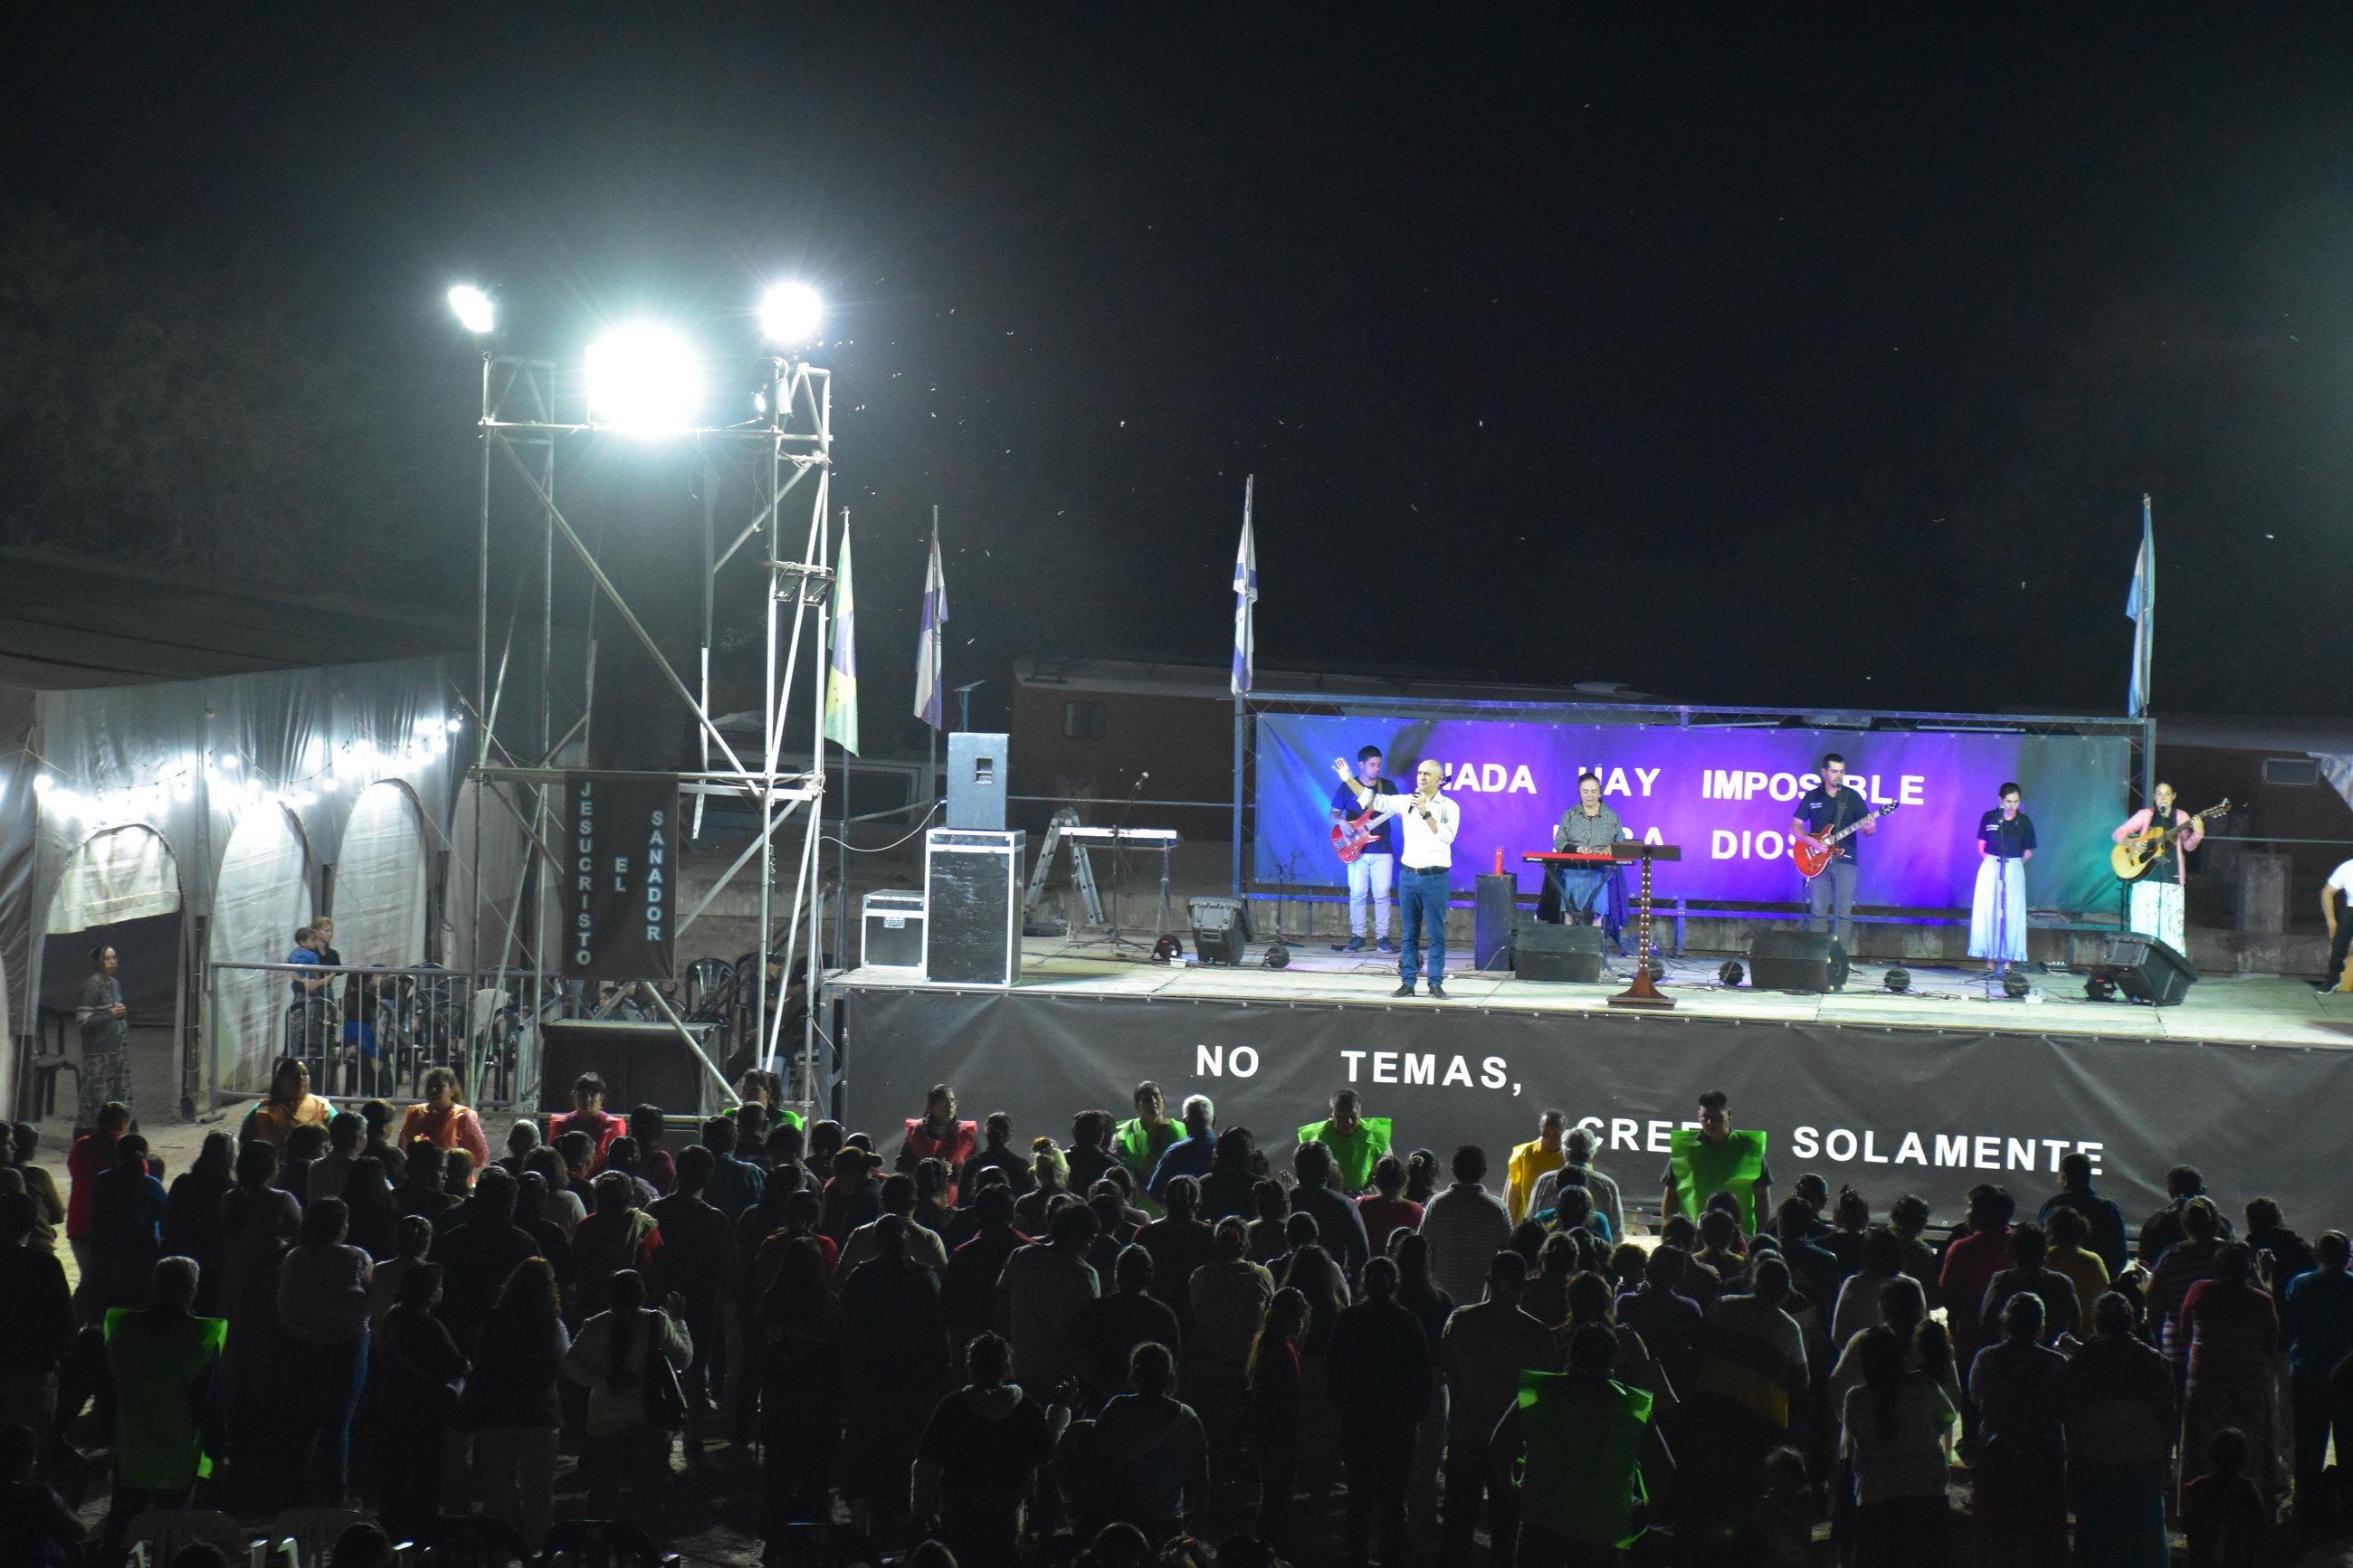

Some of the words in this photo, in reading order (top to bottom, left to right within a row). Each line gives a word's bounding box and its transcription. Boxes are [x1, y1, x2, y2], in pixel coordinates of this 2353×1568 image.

[1702, 769, 1925, 805] IMPOSBLE
[576, 782, 594, 965] JESUCRISTO
[614, 857, 629, 892] EL
[646, 810, 665, 942] SANADOR
[1196, 1044, 1260, 1079] NO
[1340, 1050, 1522, 1097] TEMAS,
[1791, 1126, 2103, 1175] SOLAMENTE
